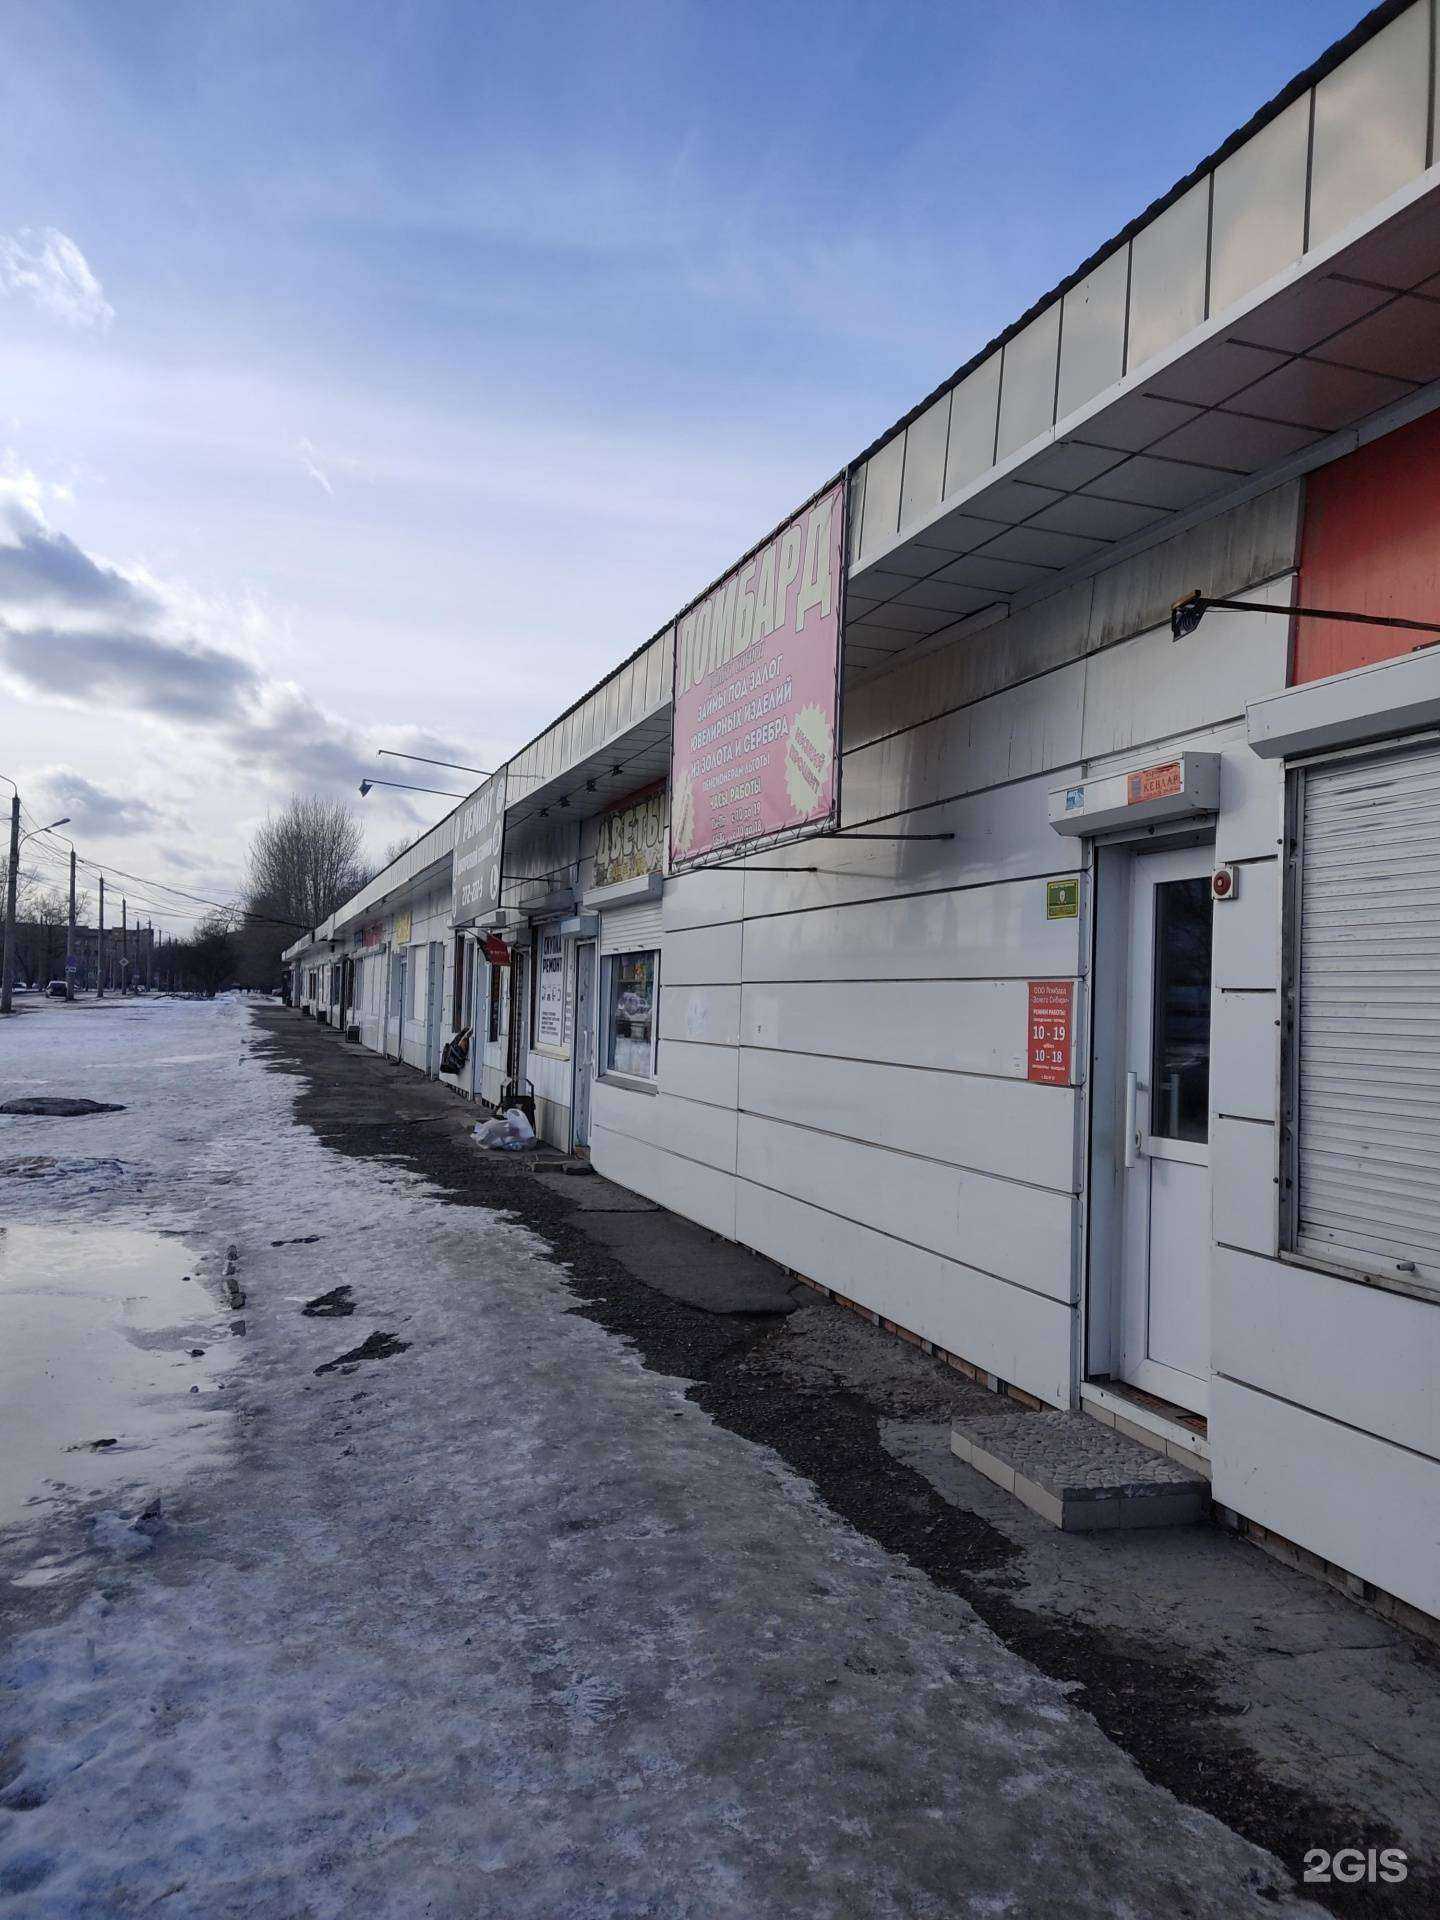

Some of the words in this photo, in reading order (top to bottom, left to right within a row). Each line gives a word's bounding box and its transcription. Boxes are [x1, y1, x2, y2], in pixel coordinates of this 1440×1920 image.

[679, 494, 837, 692] ЛОМБАРД
[690, 706, 743, 754] ЮВЕЛИРНЫХ
[742, 674, 793, 723] ИЗДЕЛИЙ
[697, 691, 727, 722] ЗАЙМЫ
[728, 678, 749, 705] ПОД
[749, 653, 783, 692] ЗАЛОГ
[691, 757, 702, 779] ИЗ
[702, 743, 734, 774] ЗОЛОТА
[735, 739, 742, 759] И
[742, 714, 790, 754] СЕРЕБРА
[744, 753, 770, 775] ЛЬГОТЫ
[463, 787, 494, 842] РЕМОНТ
[730, 777, 761, 804] РАБОТЫ
[597, 792, 666, 868] ЦВЕТЫ
[542, 957, 562, 973] РЕМОНТ
[1033, 1025, 1045, 1040] 10
[1053, 1026, 1066, 1041] 19
[1035, 1049, 1045, 1062] 10
[1052, 1050, 1063, 1063] 18
